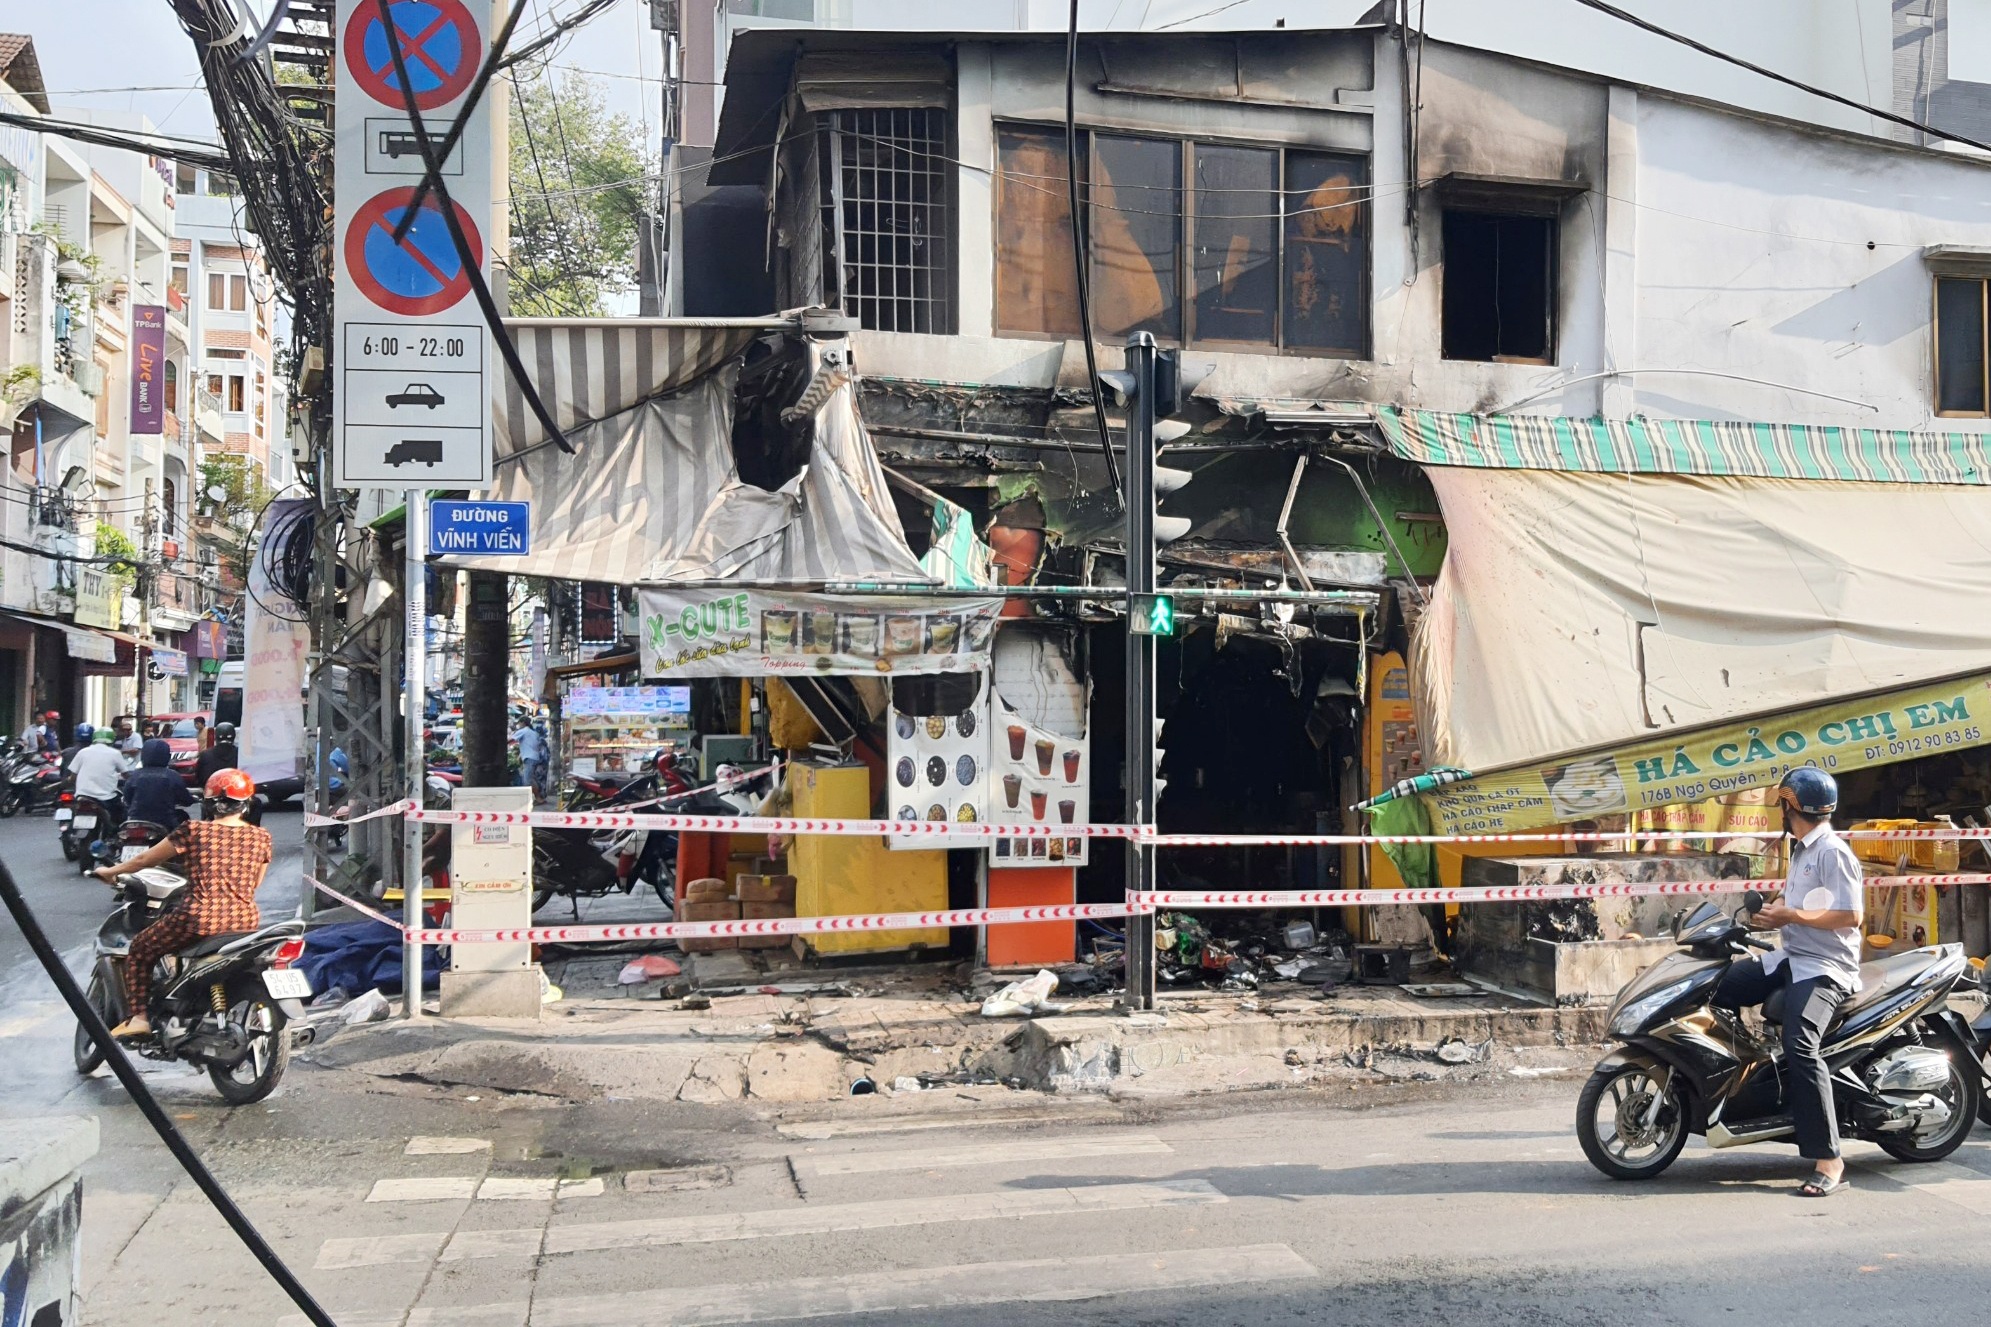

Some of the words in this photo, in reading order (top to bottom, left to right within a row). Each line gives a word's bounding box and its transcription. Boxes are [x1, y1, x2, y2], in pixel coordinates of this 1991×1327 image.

[134, 320, 162, 329] TPBank
[363, 336, 399, 356] 6:00
[419, 338, 464, 357] 22:00
[140, 343, 158, 381] Live
[139, 382, 148, 404] BANK
[451, 507, 509, 523] ĐƯỜNG
[437, 528, 477, 549] VĨNH
[483, 527, 522, 549] VIỄN
[646, 593, 750, 650] X-CUTE
[760, 656, 807, 669] Topping
[1633, 744, 1702, 784] HÁ
[1711, 727, 1807, 768] CẢO
[1817, 711, 1898, 746] CHỊ
[1904, 696, 1971, 730] EM
[1864, 746, 1886, 760] ĐT:
[1889, 738, 1922, 755] 0912
[1925, 734, 1941, 747] 90
[1945, 730, 1961, 744] 83
[1964, 726, 1981, 740] 85
[1463, 794, 1485, 804] QUA
[1640, 786, 1672, 804] 176B
[1675, 781, 1705, 799] Ngô
